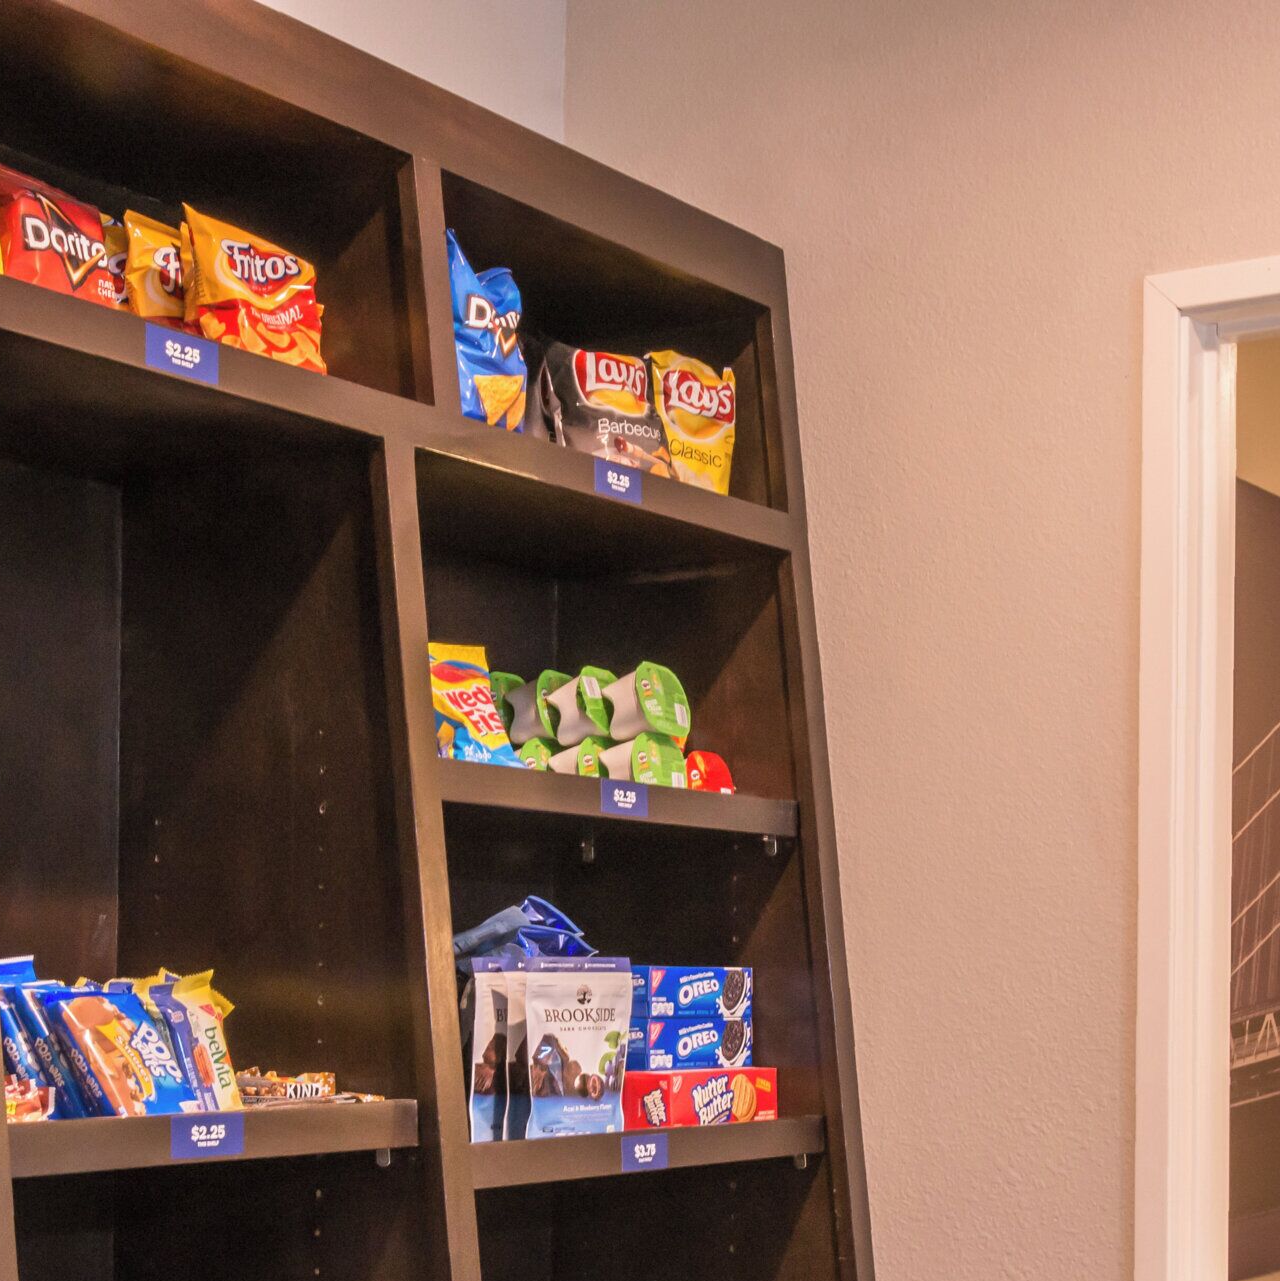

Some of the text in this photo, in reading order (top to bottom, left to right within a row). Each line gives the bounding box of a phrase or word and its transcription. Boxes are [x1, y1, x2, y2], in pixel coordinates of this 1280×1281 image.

[222, 238, 297, 284] Fritos
[261, 305, 303, 327] ORIGINAL
[165, 339, 200, 364] $2.25
[587, 352, 646, 395] Lay's
[669, 369, 732, 417] Lay's
[670, 439, 721, 468] Classic
[608, 470, 630, 487] $2.25
[614, 789, 636, 803] $2.25
[679, 979, 719, 1005] OREO
[545, 1008, 616, 1024] BROOKSIDE
[678, 1030, 719, 1058] OREO
[693, 1076, 727, 1110] Nutter
[700, 1091, 733, 1124] Butter
[191, 1124, 226, 1141] $2.25
